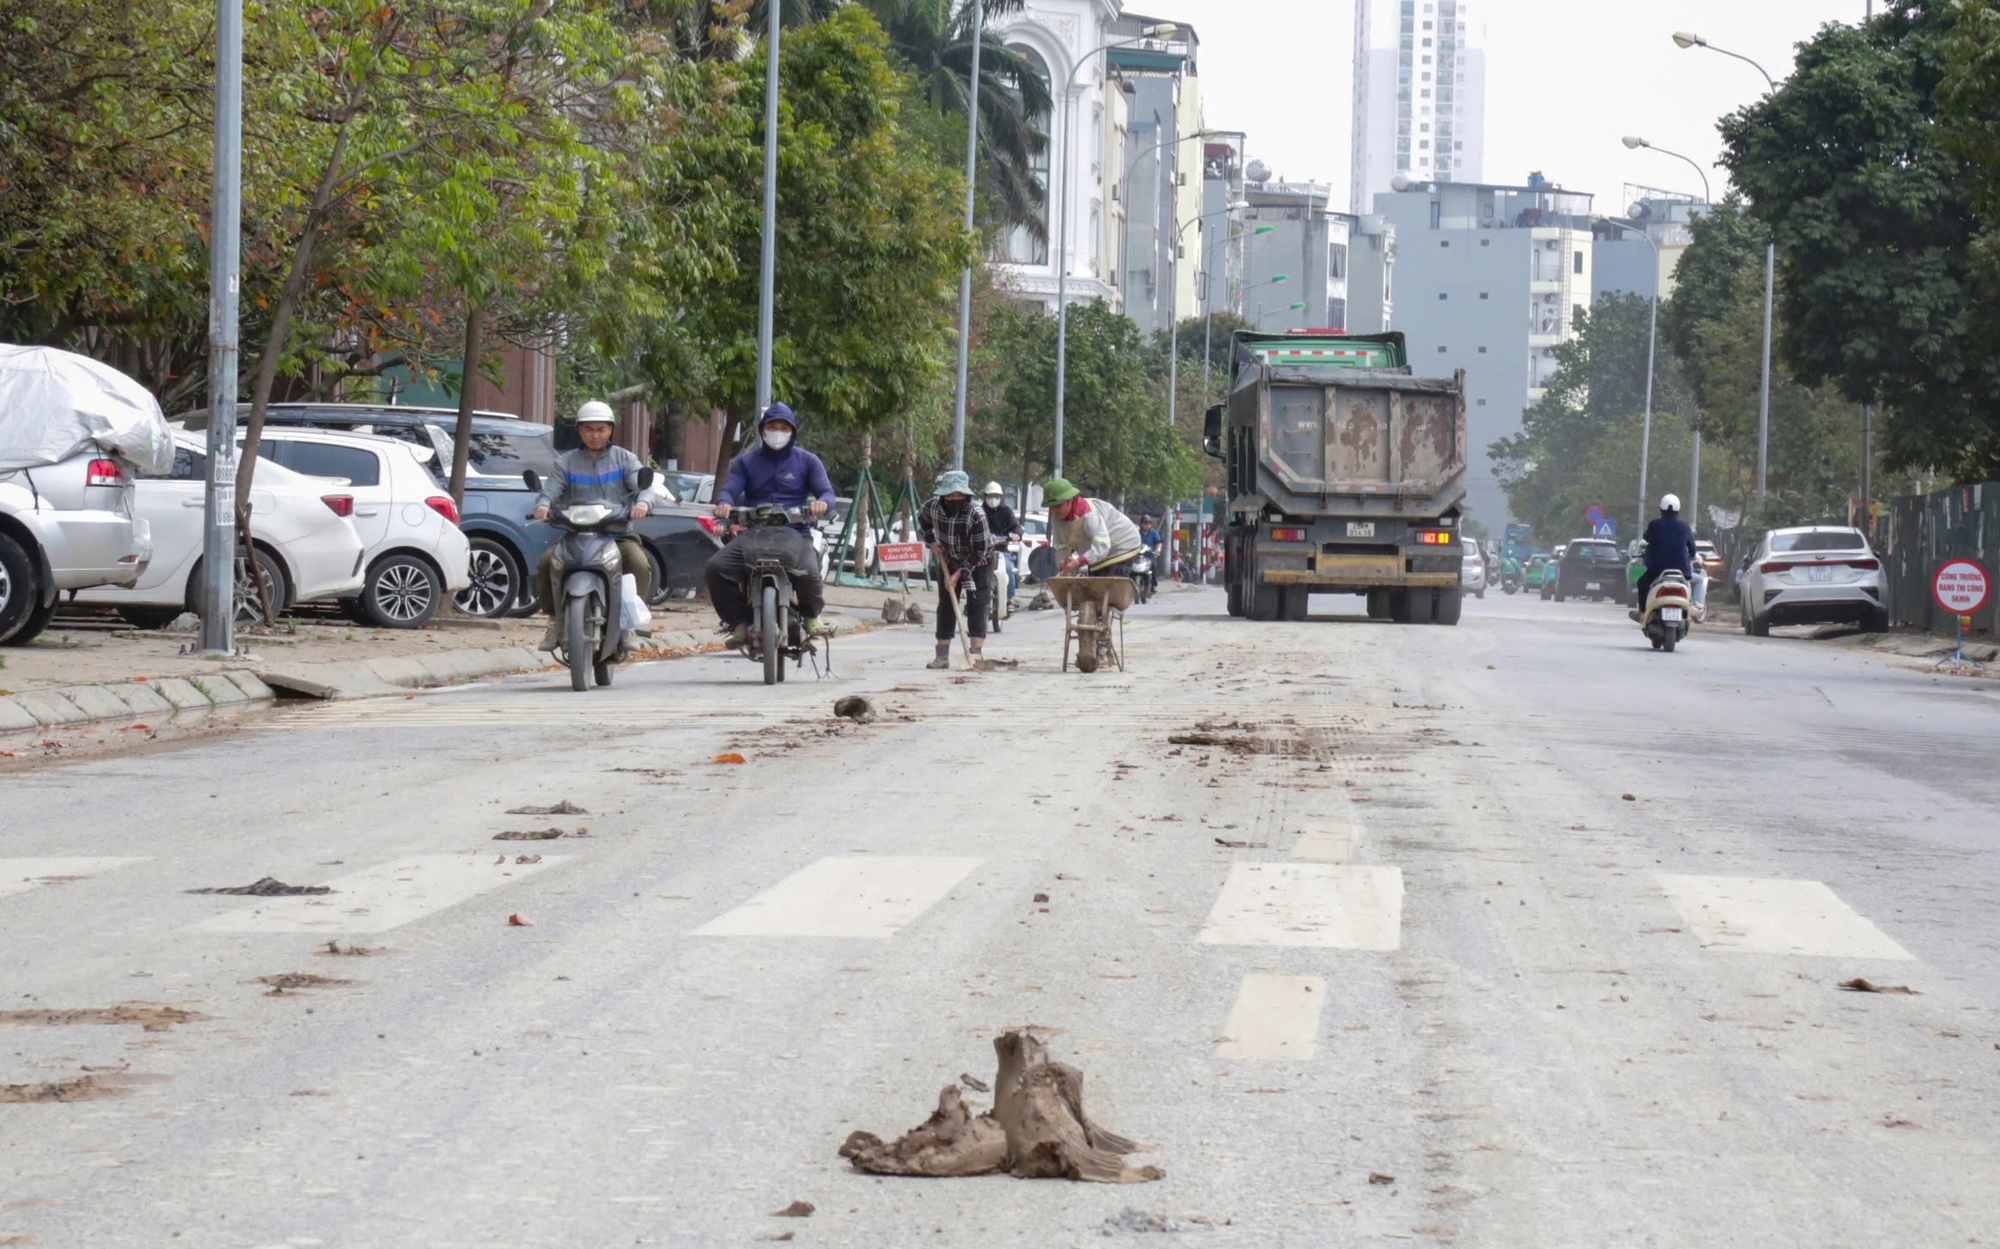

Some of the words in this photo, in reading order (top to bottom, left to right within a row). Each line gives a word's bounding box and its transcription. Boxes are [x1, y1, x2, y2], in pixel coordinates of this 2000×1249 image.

[1940, 572, 1957, 581] CÔNG
[1958, 572, 1982, 582] TRƯỜNG
[1938, 583, 1955, 592] ĐANG
[1956, 584, 1966, 592] THI
[1966, 584, 1983, 593] CÔNG
